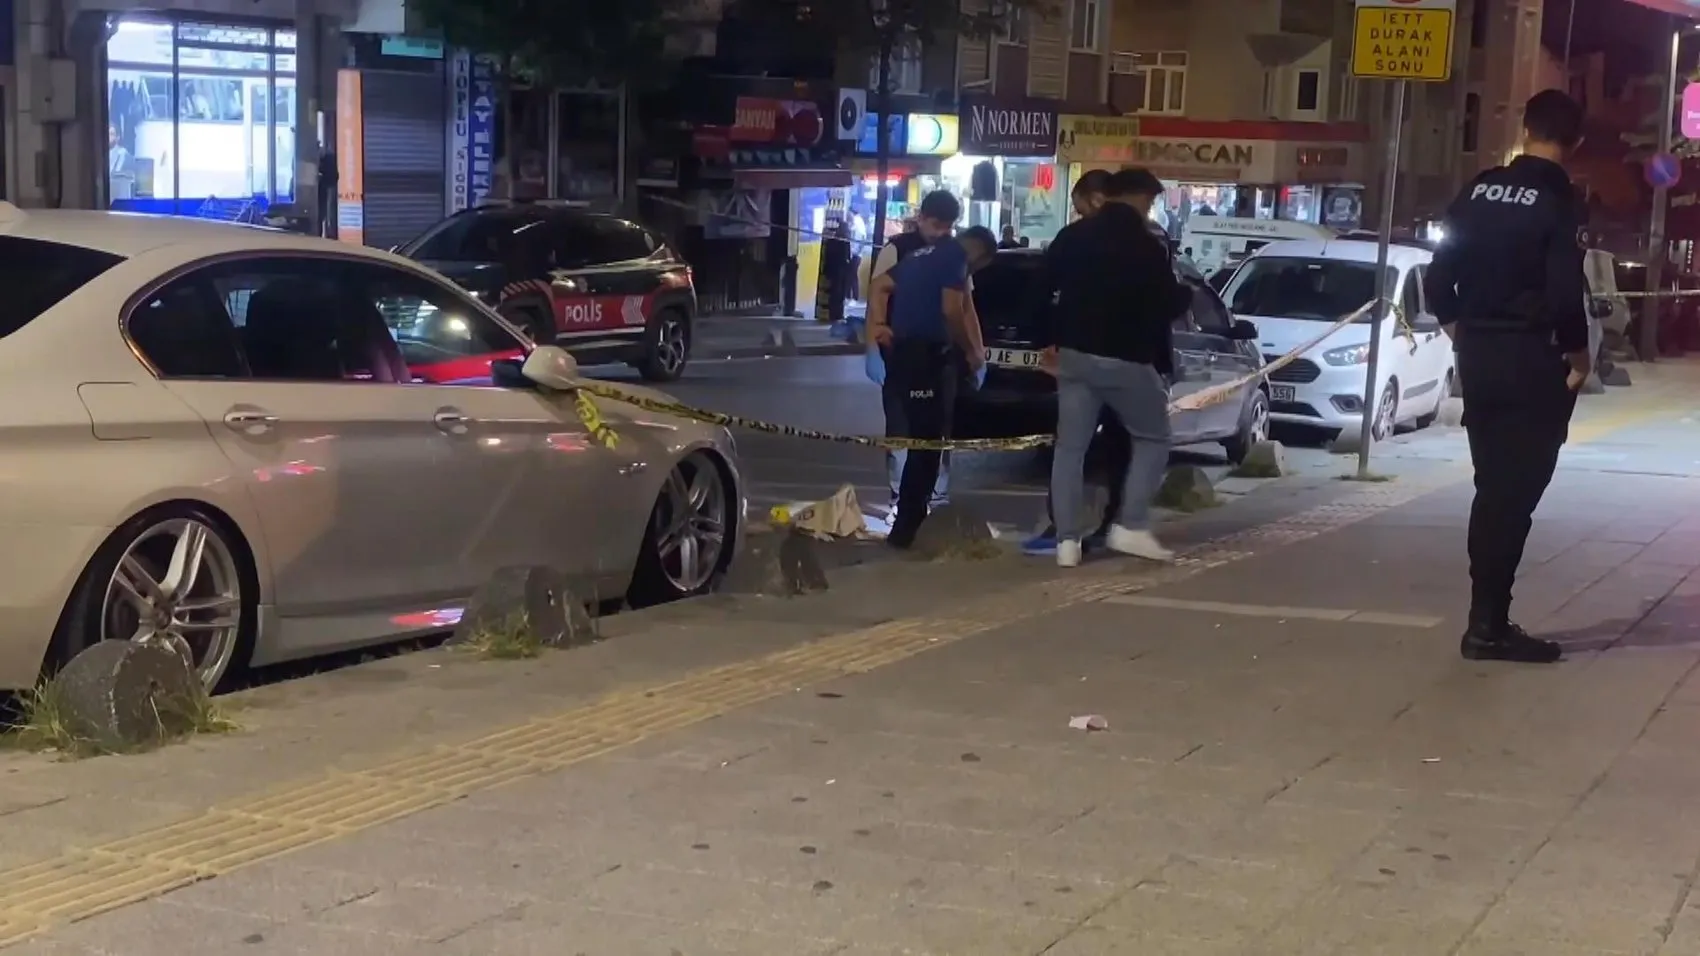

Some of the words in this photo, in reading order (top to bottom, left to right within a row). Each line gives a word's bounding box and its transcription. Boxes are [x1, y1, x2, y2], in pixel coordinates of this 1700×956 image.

[1370, 27, 1432, 41] DURAK
[1372, 44, 1430, 58] ALANI
[1375, 59, 1424, 73] SONU
[987, 110, 1052, 136] NORMEN
